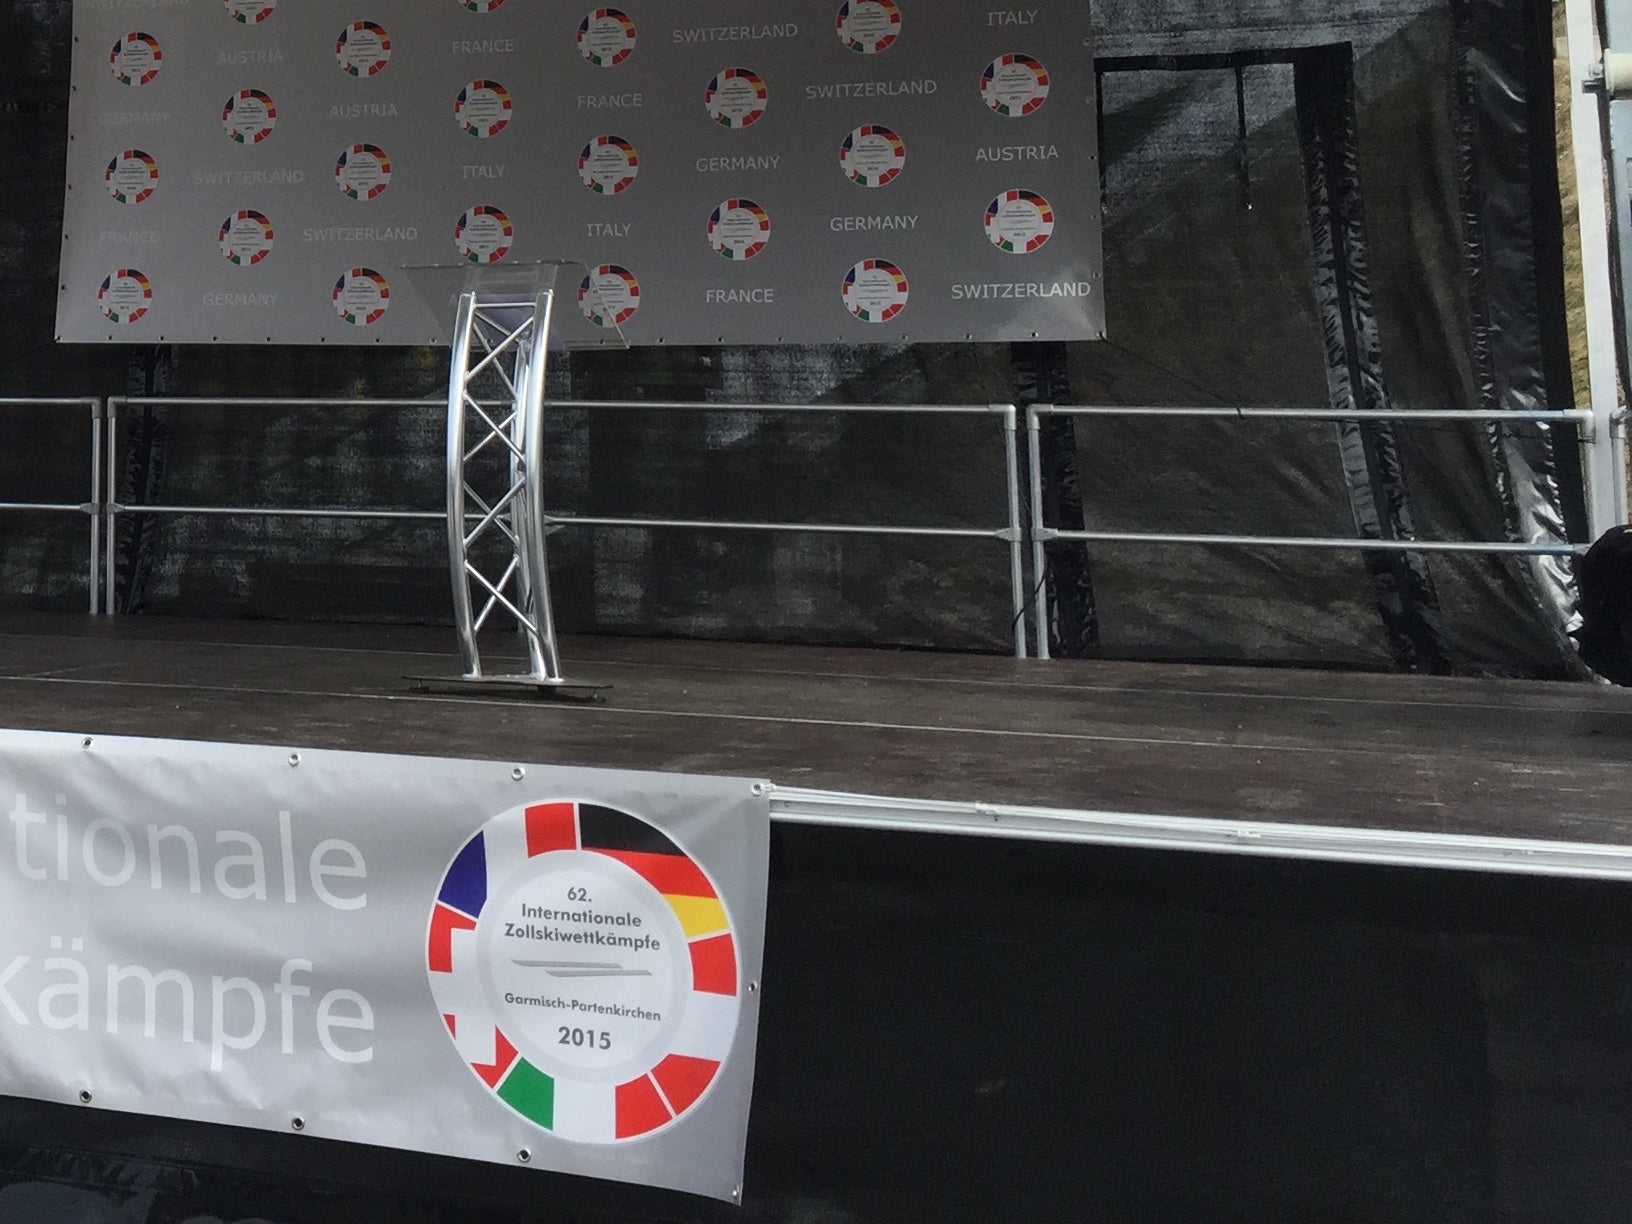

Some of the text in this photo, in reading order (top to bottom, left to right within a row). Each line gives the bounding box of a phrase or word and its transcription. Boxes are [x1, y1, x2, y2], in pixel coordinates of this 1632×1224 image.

[987, 10, 1038, 26] ITALY
[672, 24, 798, 43] SWITZERLAND
[452, 39, 514, 54] FRANCE
[218, 50, 282, 64] AUSTRIA
[806, 80, 937, 99] SWITZERLAND
[577, 93, 642, 108] FRANCE
[330, 104, 398, 118] AUSTRIA
[976, 145, 1058, 162] AUSTRIA
[696, 156, 780, 172] GERMANY
[194, 170, 304, 184] SWITZERLAND
[462, 165, 504, 180] ITALY
[586, 223, 630, 237] ITALY
[830, 215, 918, 232] GERMANY
[303, 226, 418, 242] SWITZERLAND
[706, 288, 774, 303] FRANCE
[951, 282, 1091, 300] SWITZERLAND
[203, 292, 278, 307] GERMANY
[568, 887, 592, 902] 62.
[521, 904, 642, 927] Internationale
[505, 923, 661, 951] Zollskiwettkämpfe
[505, 993, 661, 1021] Garmisch-Partenkirchen
[559, 1026, 611, 1050] 2015
